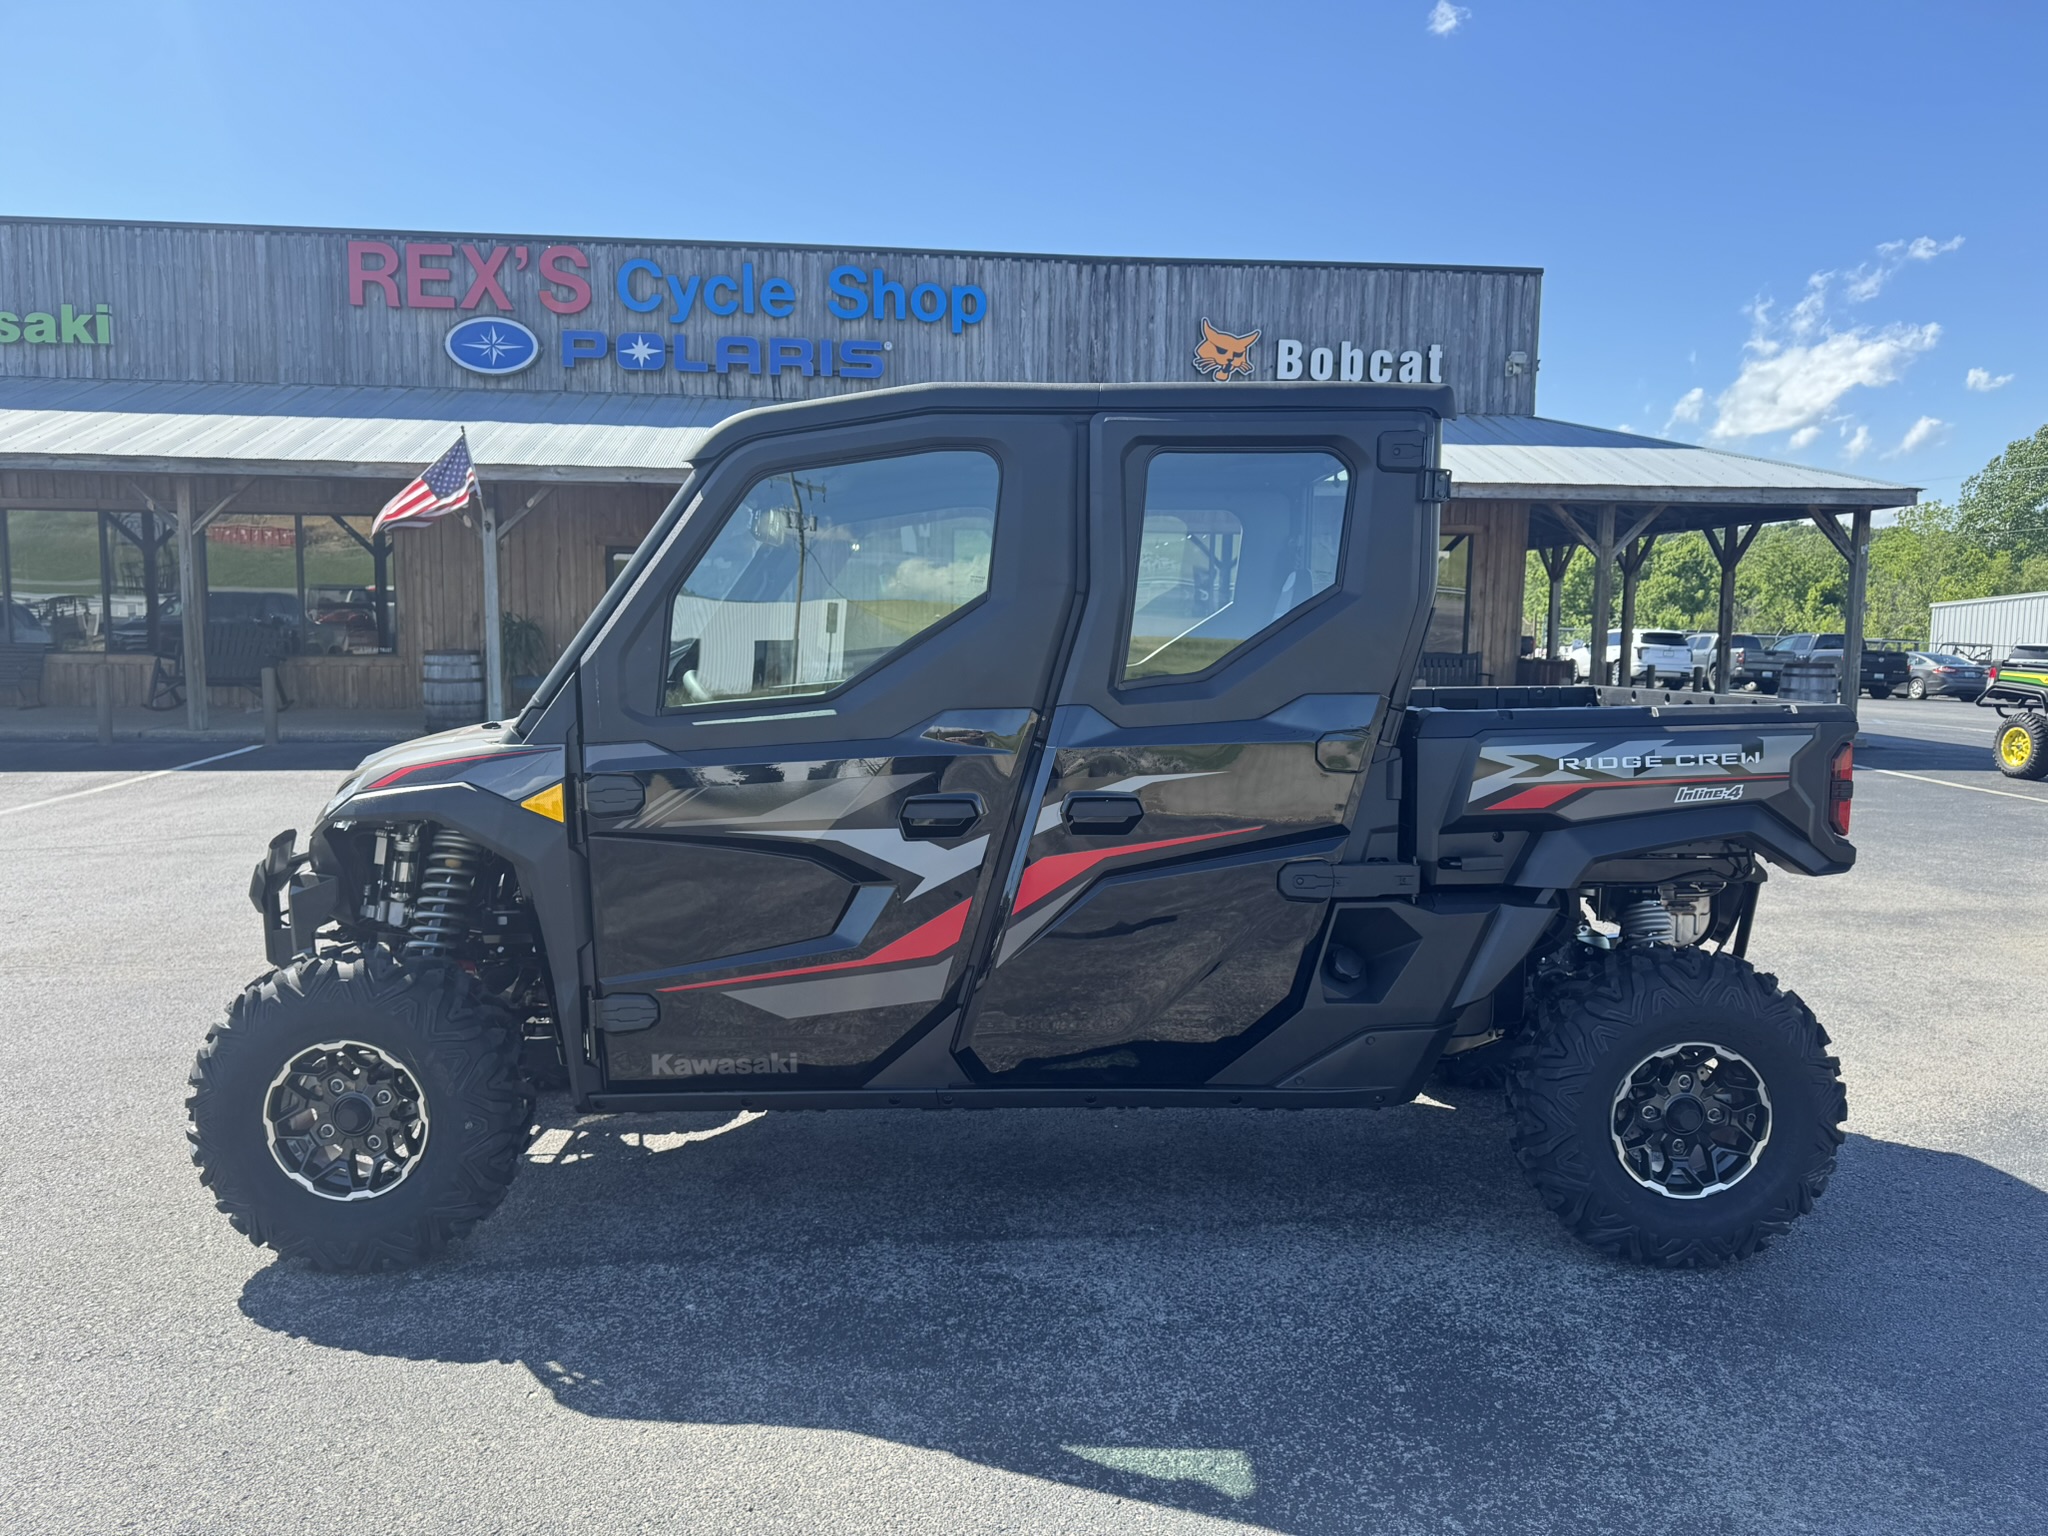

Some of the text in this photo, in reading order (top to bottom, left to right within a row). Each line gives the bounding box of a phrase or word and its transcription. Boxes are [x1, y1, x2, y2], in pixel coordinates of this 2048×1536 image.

[349, 241, 988, 334] REX'S Cycle Shop
[0, 303, 112, 344] saki
[1276, 339, 1443, 383] Bobcat
[1558, 752, 1760, 771] RIDGE CREW
[1674, 784, 1744, 803] Inline-4
[651, 1052, 798, 1076] Kawasaki
